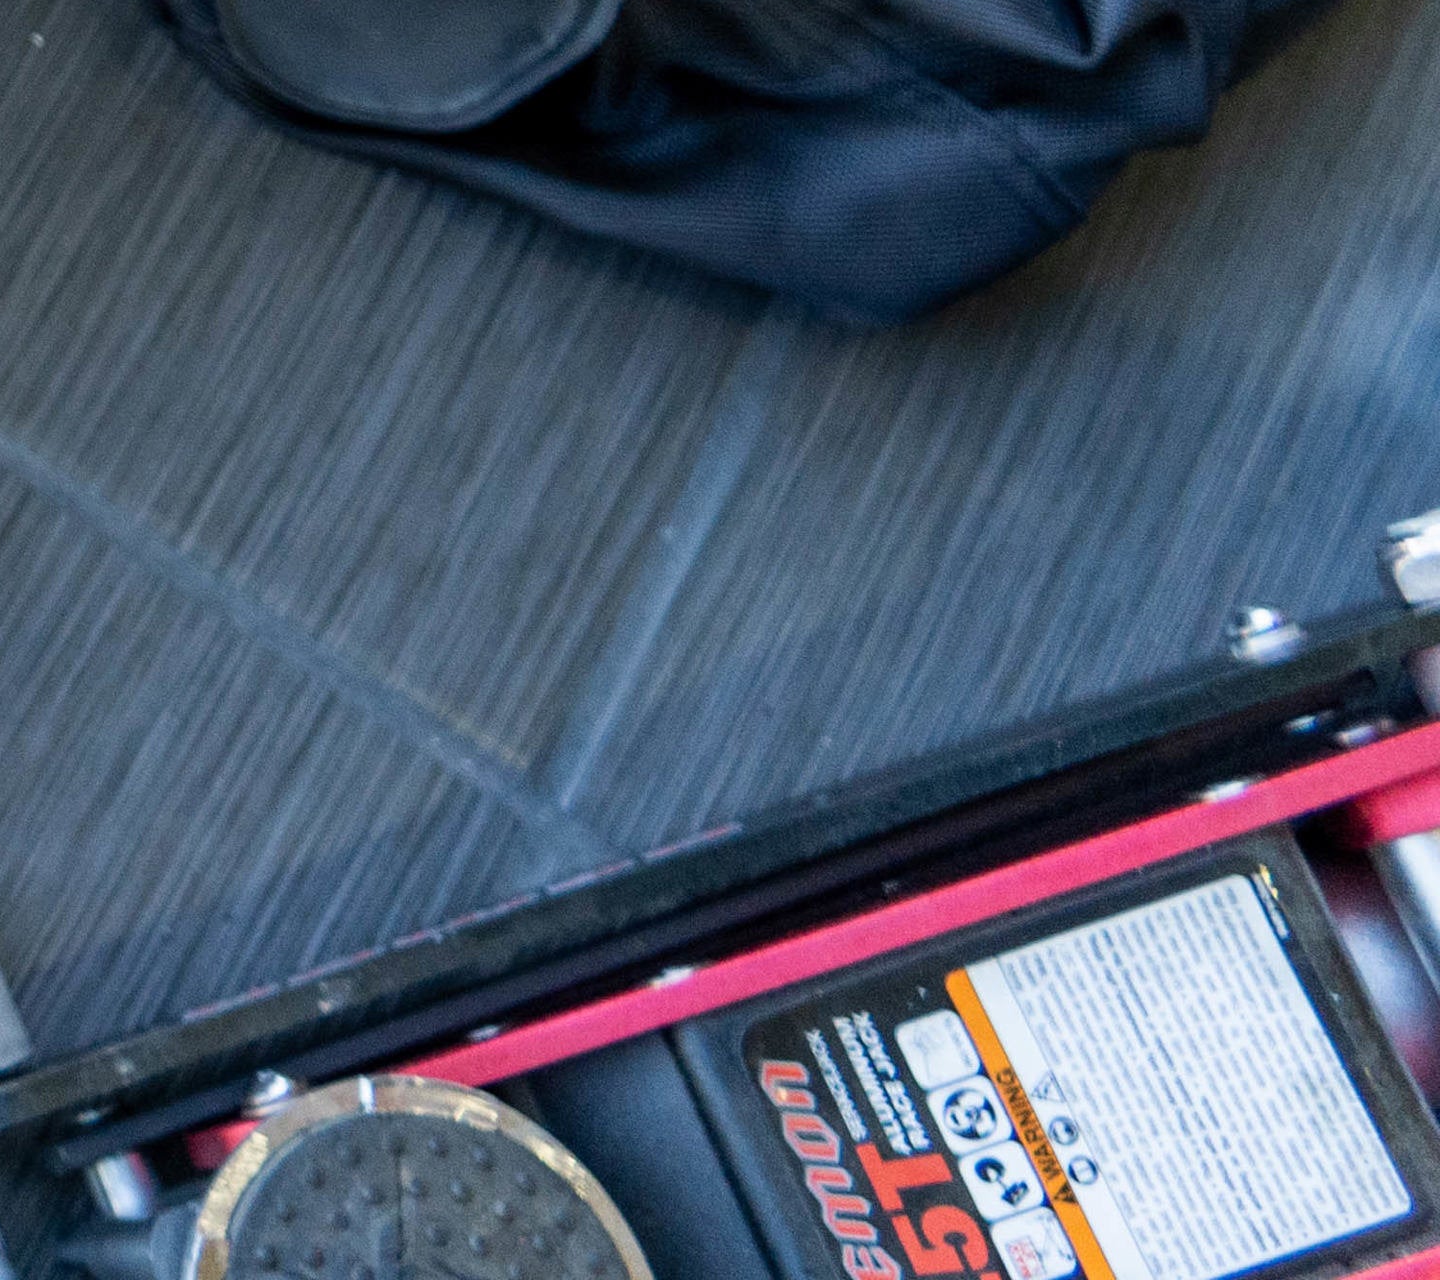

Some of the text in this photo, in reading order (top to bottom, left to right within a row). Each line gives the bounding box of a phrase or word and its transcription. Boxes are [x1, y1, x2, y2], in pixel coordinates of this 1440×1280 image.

[830, 1015, 912, 1153] ALUMINUM
[850, 1011, 931, 1150] RACE JACK
[995, 1067, 1062, 1181] WARNING
